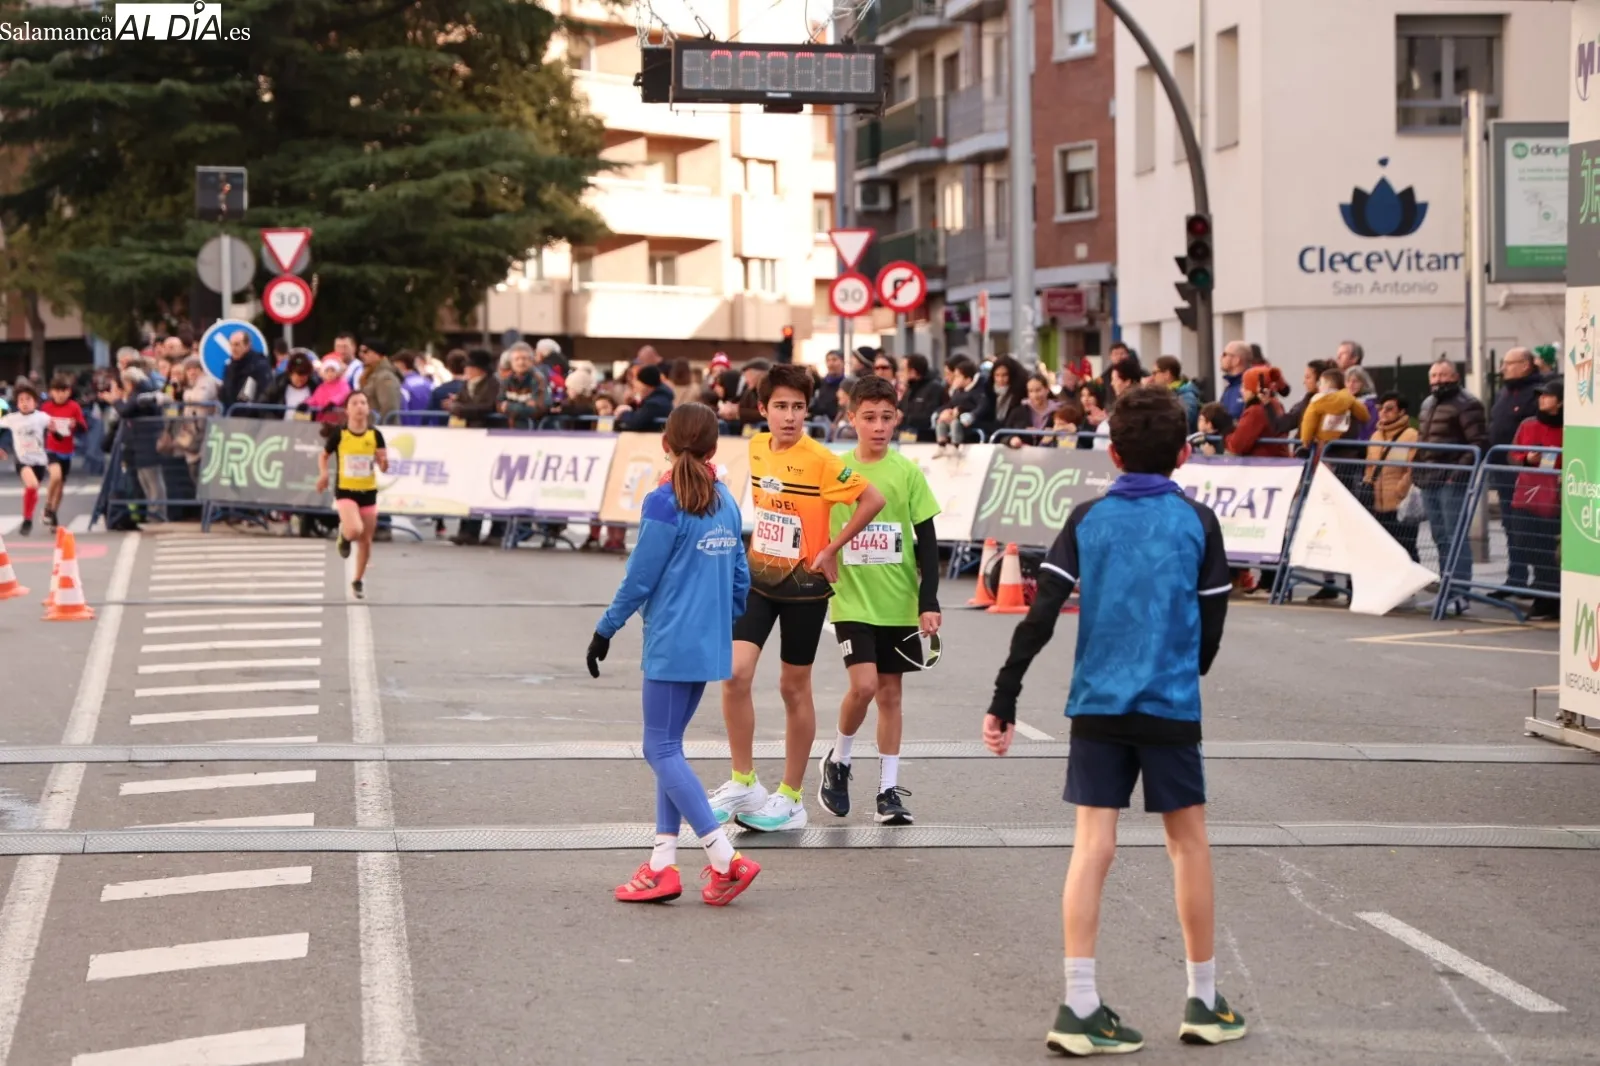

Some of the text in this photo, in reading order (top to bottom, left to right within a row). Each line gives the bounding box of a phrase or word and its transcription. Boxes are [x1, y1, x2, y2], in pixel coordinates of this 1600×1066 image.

[838, 288, 864, 304] 30
[1332, 280, 1438, 295] San Antonio
[276, 293, 300, 308] 30
[201, 424, 289, 488] JRG
[978, 453, 1081, 529] JRG
[757, 520, 785, 543] 6531
[850, 533, 889, 551] 6443
